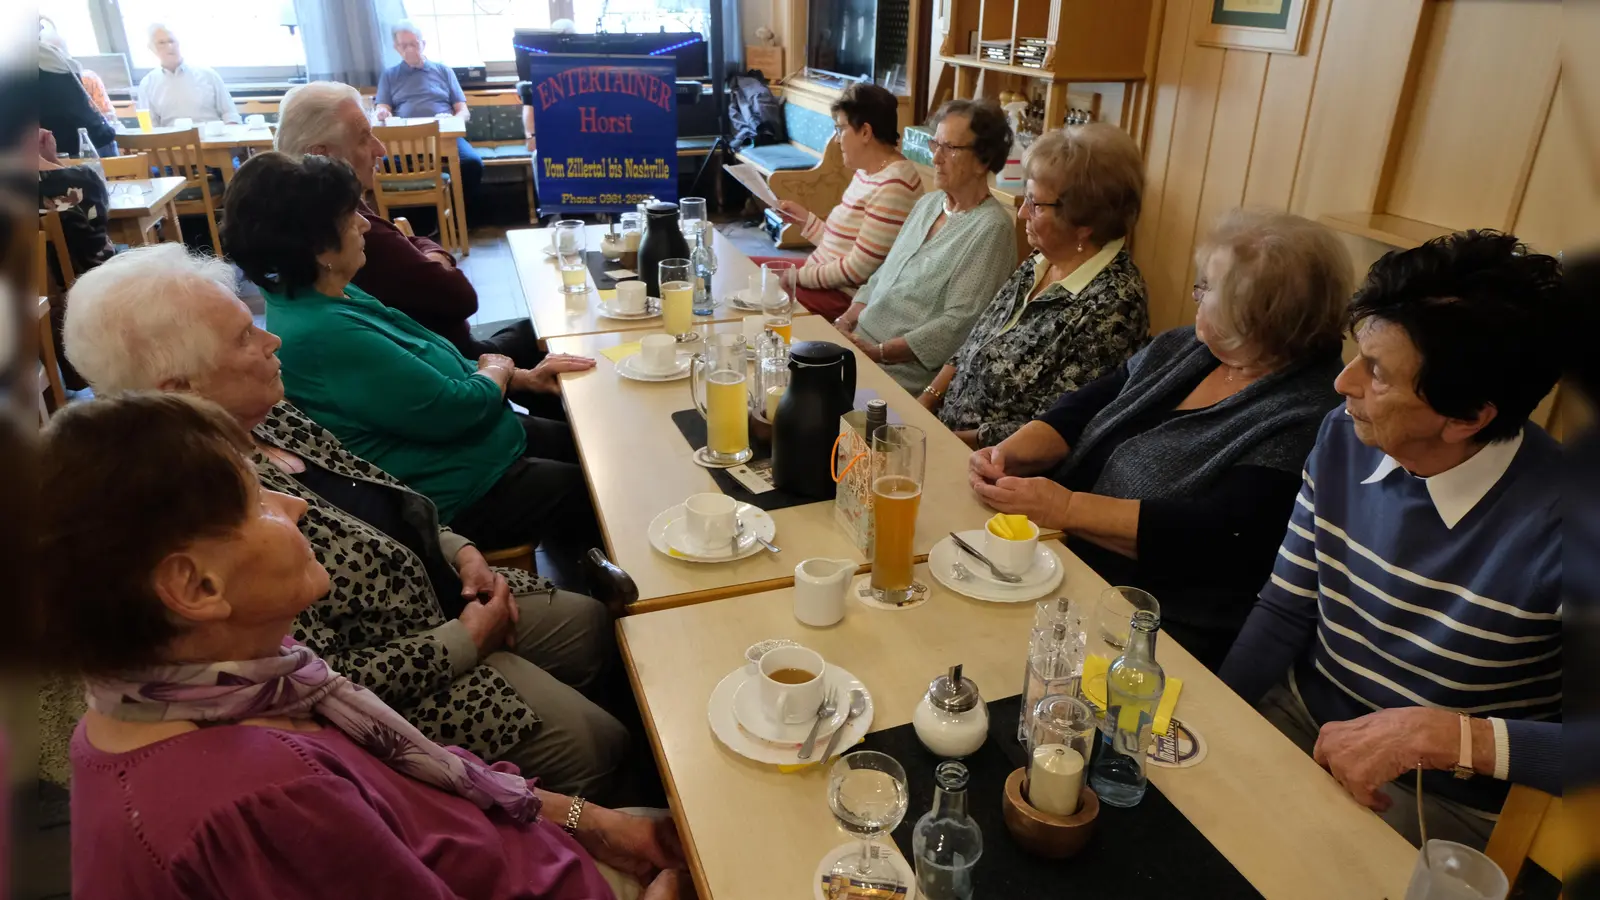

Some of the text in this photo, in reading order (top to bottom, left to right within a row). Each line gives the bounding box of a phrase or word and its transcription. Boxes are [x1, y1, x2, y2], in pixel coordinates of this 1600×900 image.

[537, 66, 672, 112] ENTERTAINER
[578, 106, 633, 134] Horst
[544, 157, 670, 180] Vom Zillertal bis Nashville
[561, 192, 597, 204] Phone:
